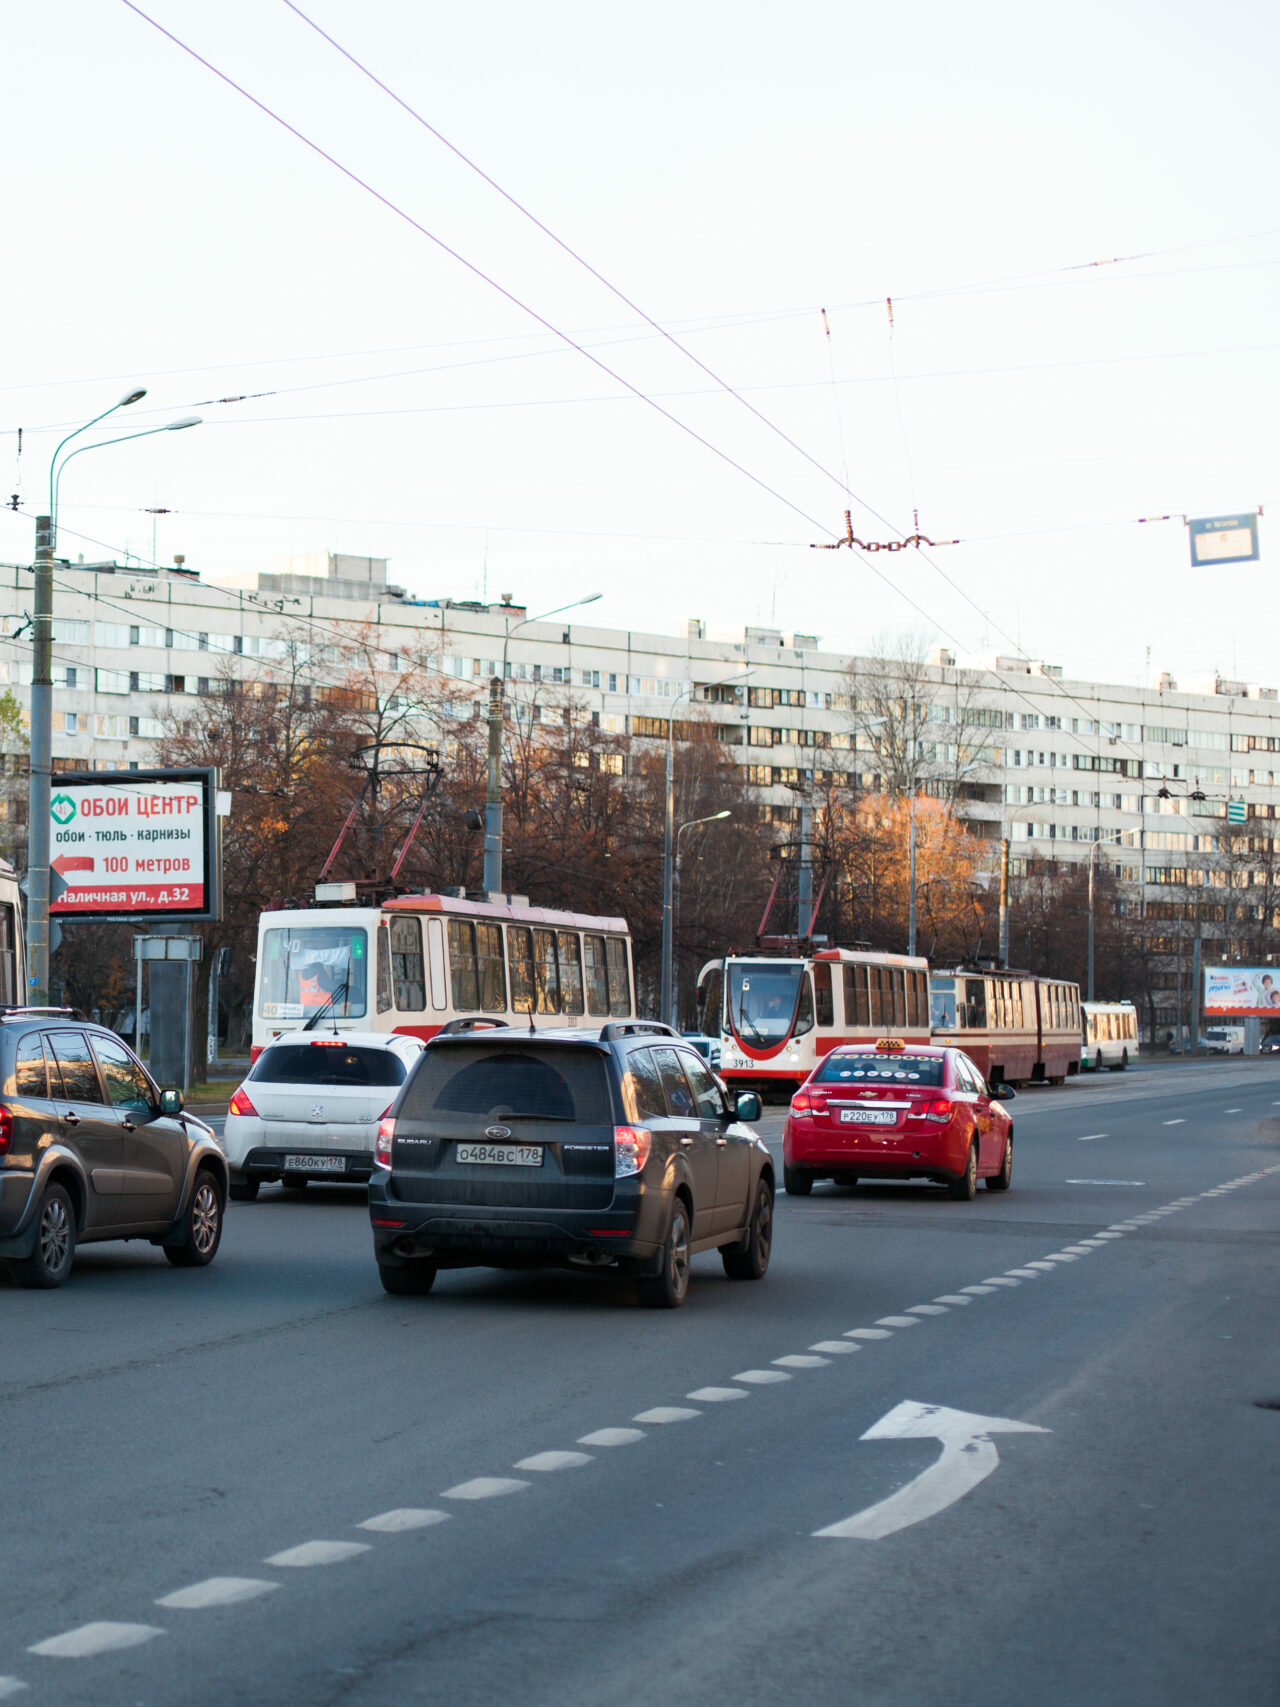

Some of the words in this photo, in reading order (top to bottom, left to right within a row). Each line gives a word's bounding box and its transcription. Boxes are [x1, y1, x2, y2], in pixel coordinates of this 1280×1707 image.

[81, 797, 129, 817] ОБОИ
[137, 796, 198, 818] ЦЕНТР
[56, 829, 85, 843] обои
[95, 830, 127, 842] тюль
[137, 829, 190, 843] карнизы
[103, 856, 129, 873] 100
[135, 858, 190, 875] метров
[57, 890, 127, 903] Наличная
[130, 890, 155, 904] ул.,
[158, 887, 190, 904] д.32
[283, 939, 300, 953] 40
[742, 977, 750, 991] 6
[264, 1004, 278, 1015] 40
[733, 1059, 754, 1069] 3913
[880, 1112, 894, 1120] 178
[518, 1147, 539, 1160] 178
[329, 1157, 342, 1166] 178
